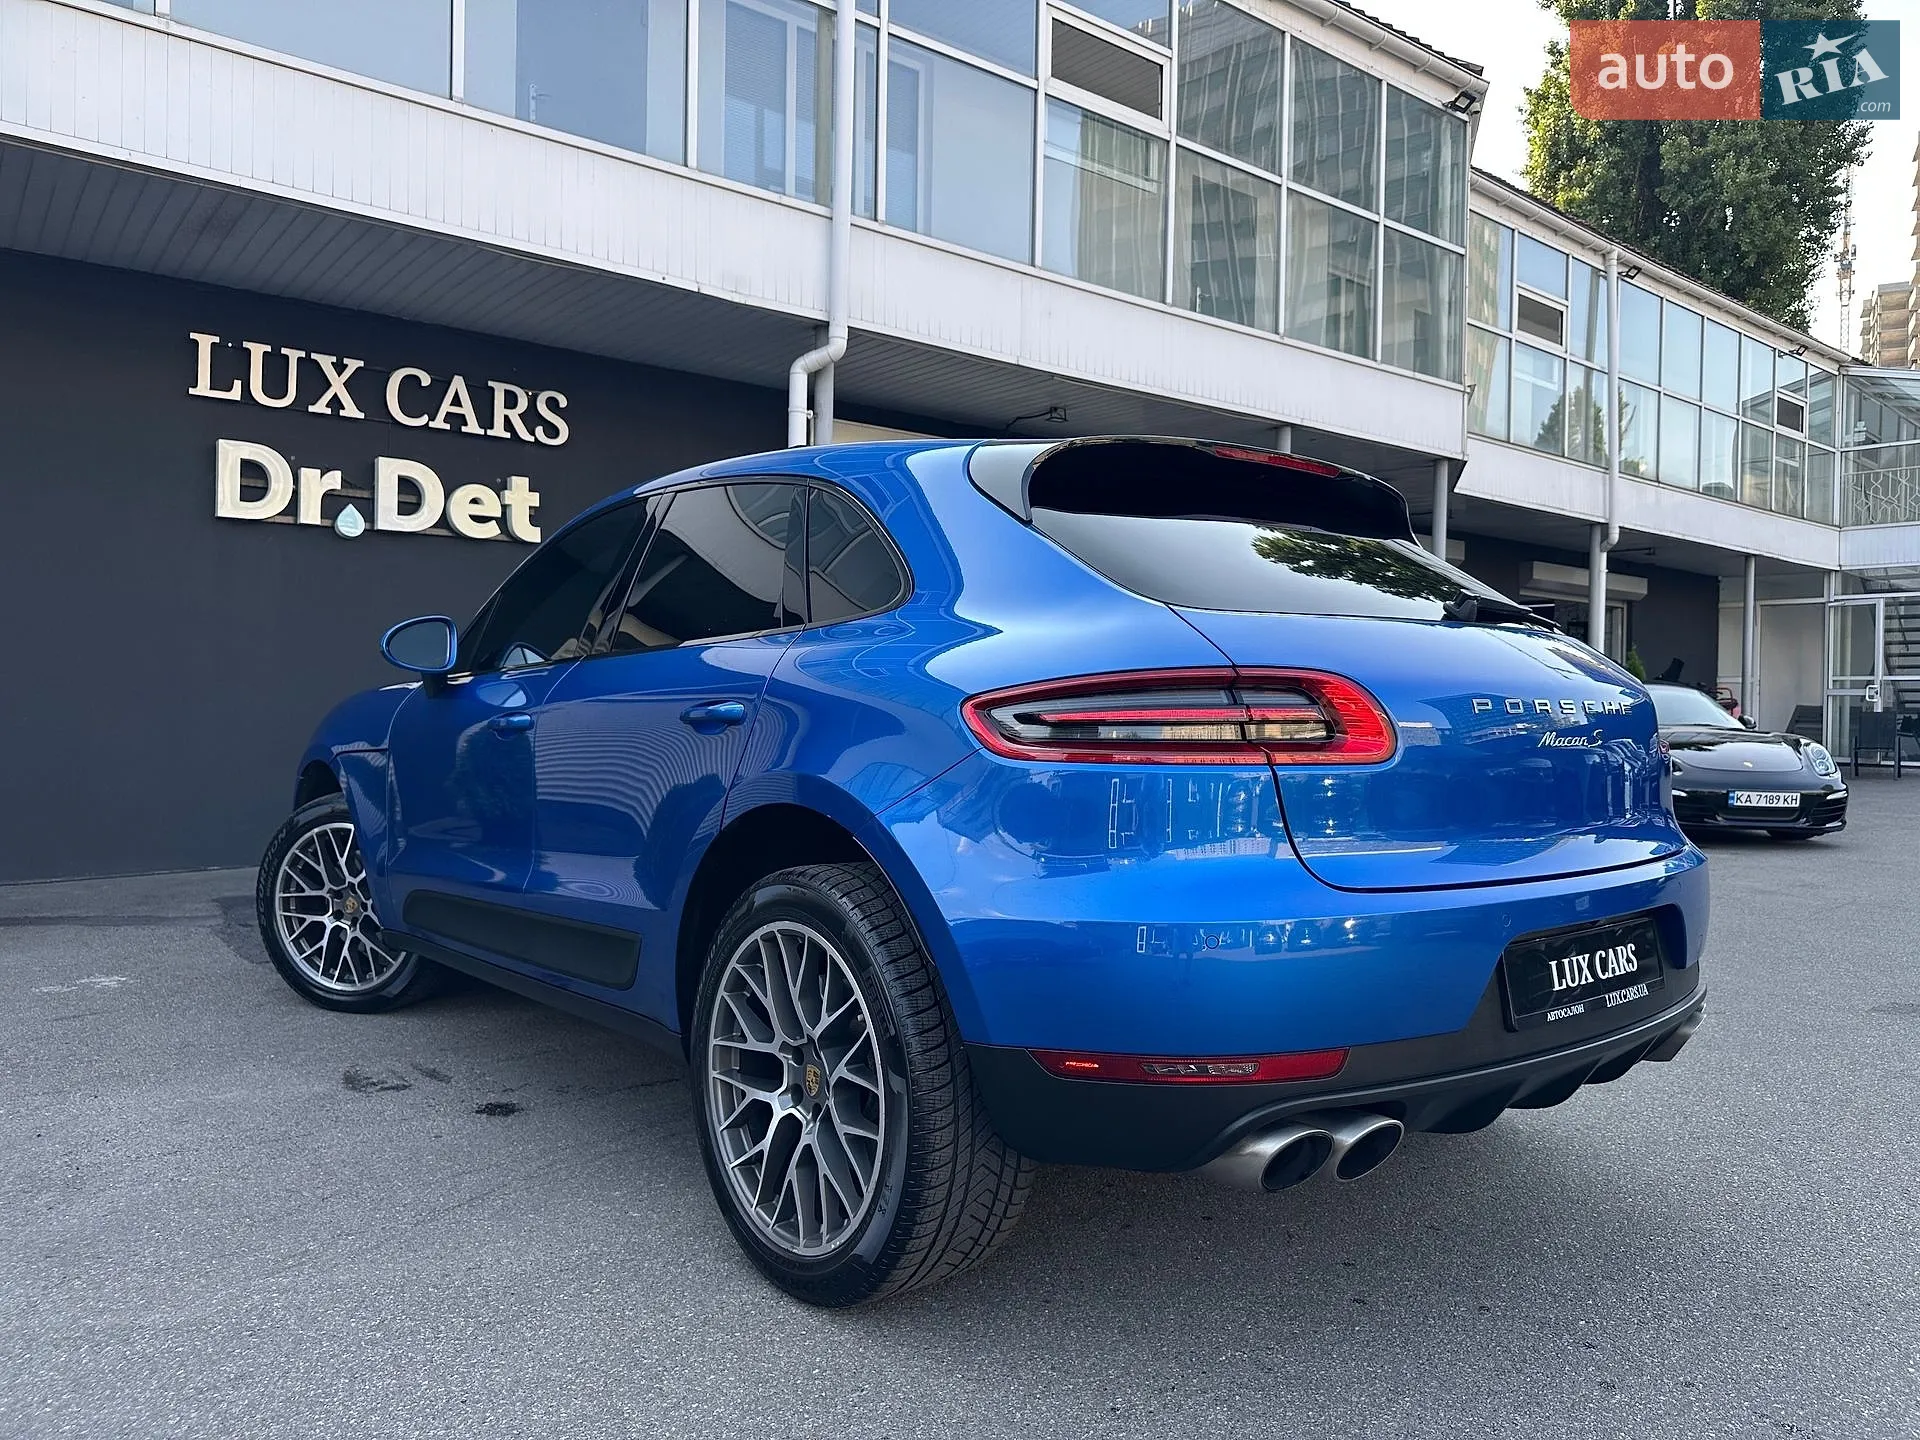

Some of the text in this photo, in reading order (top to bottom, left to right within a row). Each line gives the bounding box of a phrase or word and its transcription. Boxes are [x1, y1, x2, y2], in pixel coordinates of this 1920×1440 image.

[188, 332, 570, 446] LUX CARS
[1472, 698, 1633, 715] PORSCHE
[1538, 729, 1603, 748] Macan S
[1735, 793, 1798, 805] KA 7189 KH
[1549, 943, 1638, 991] LUX CARS
[1547, 1004, 1585, 1021] АВТОСАЛОН
